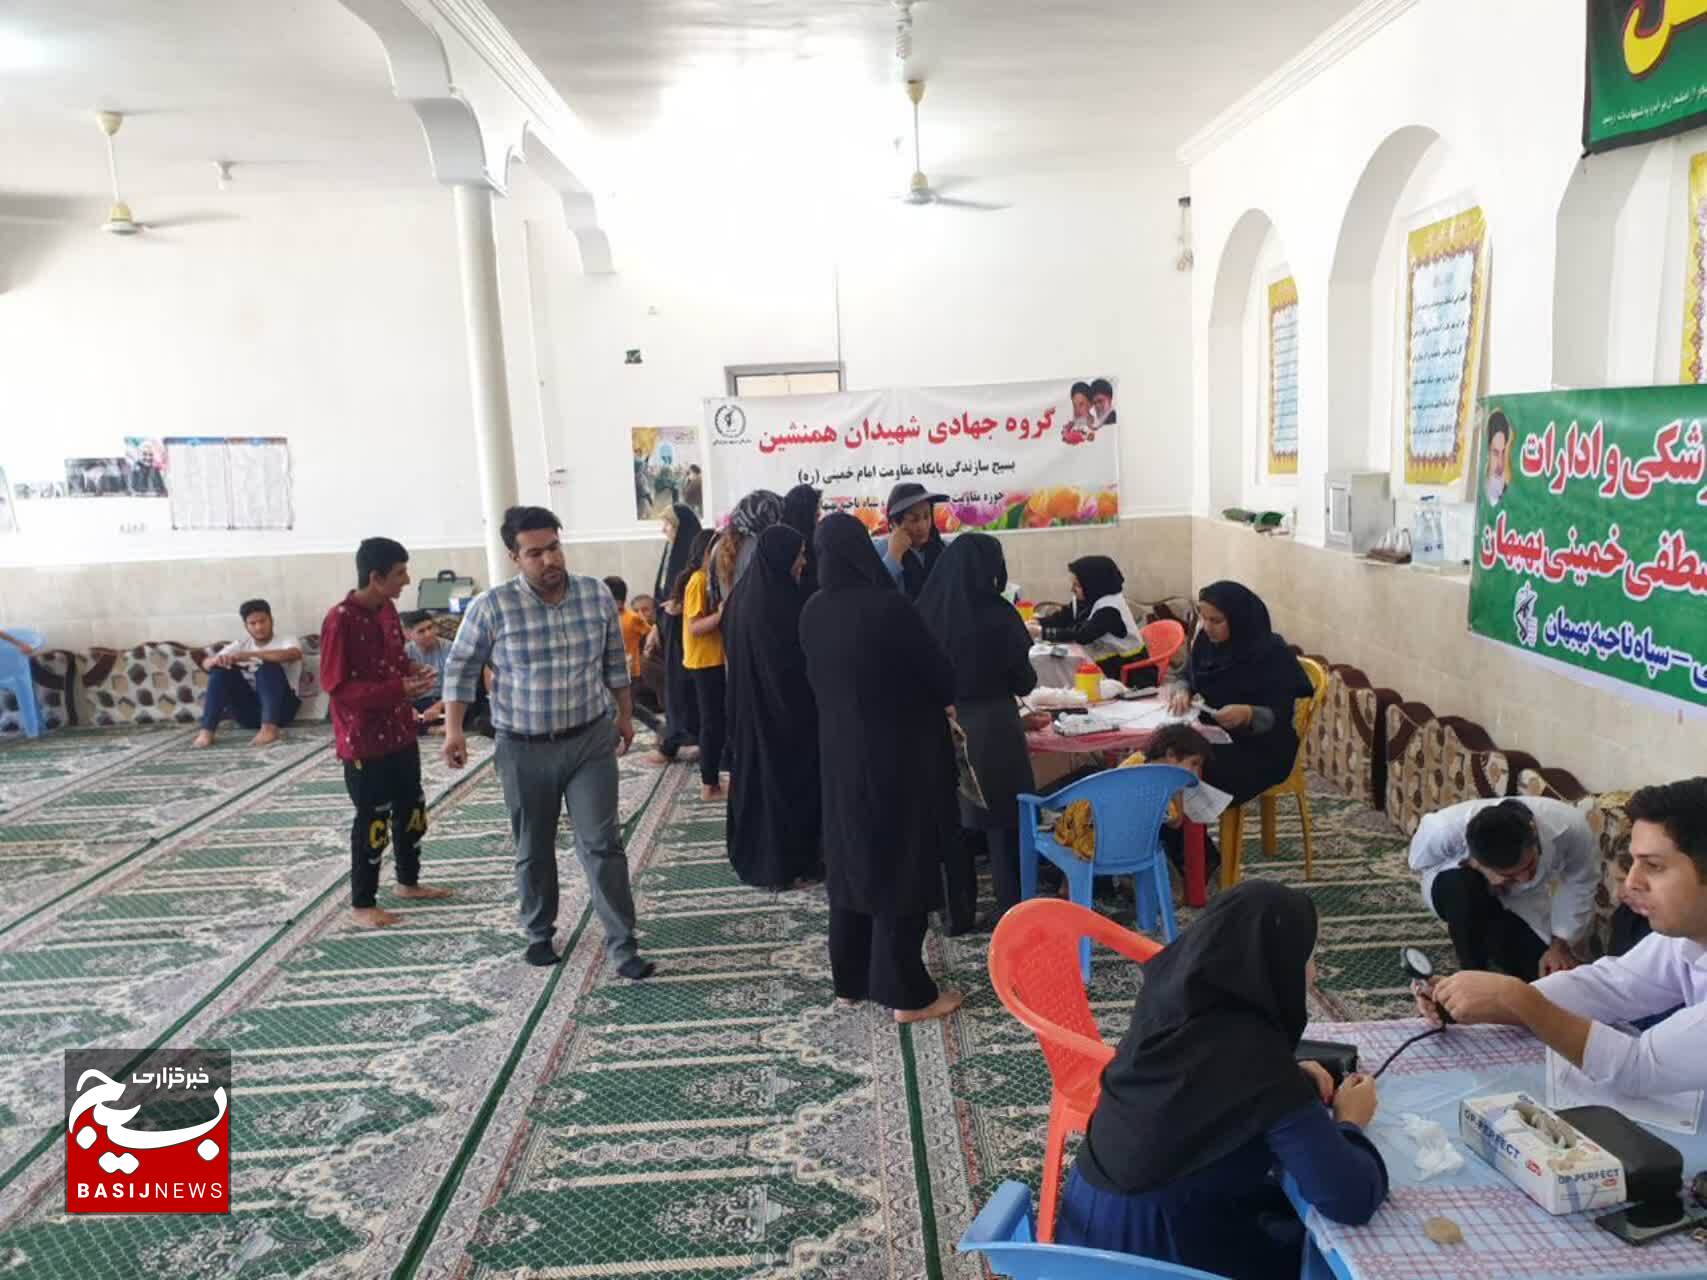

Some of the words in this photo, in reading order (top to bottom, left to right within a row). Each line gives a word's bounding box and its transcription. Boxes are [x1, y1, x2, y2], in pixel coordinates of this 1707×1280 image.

[758, 421, 837, 453] همنشین
[844, 415, 921, 448] شهیدان
[927, 411, 998, 444] جهادی
[1005, 406, 1056, 440] گروه
[856, 465, 877, 482] امام
[879, 463, 914, 481] مقاومت
[916, 461, 943, 479] پایگاه
[945, 459, 989, 478] سازندگی
[992, 459, 1016, 475] بسیج
[1520, 420, 1603, 494] ادارات
[1479, 510, 1545, 578] بهبهان
[1542, 523, 1628, 587] خمینی
[1543, 606, 1592, 656] بهبهان
